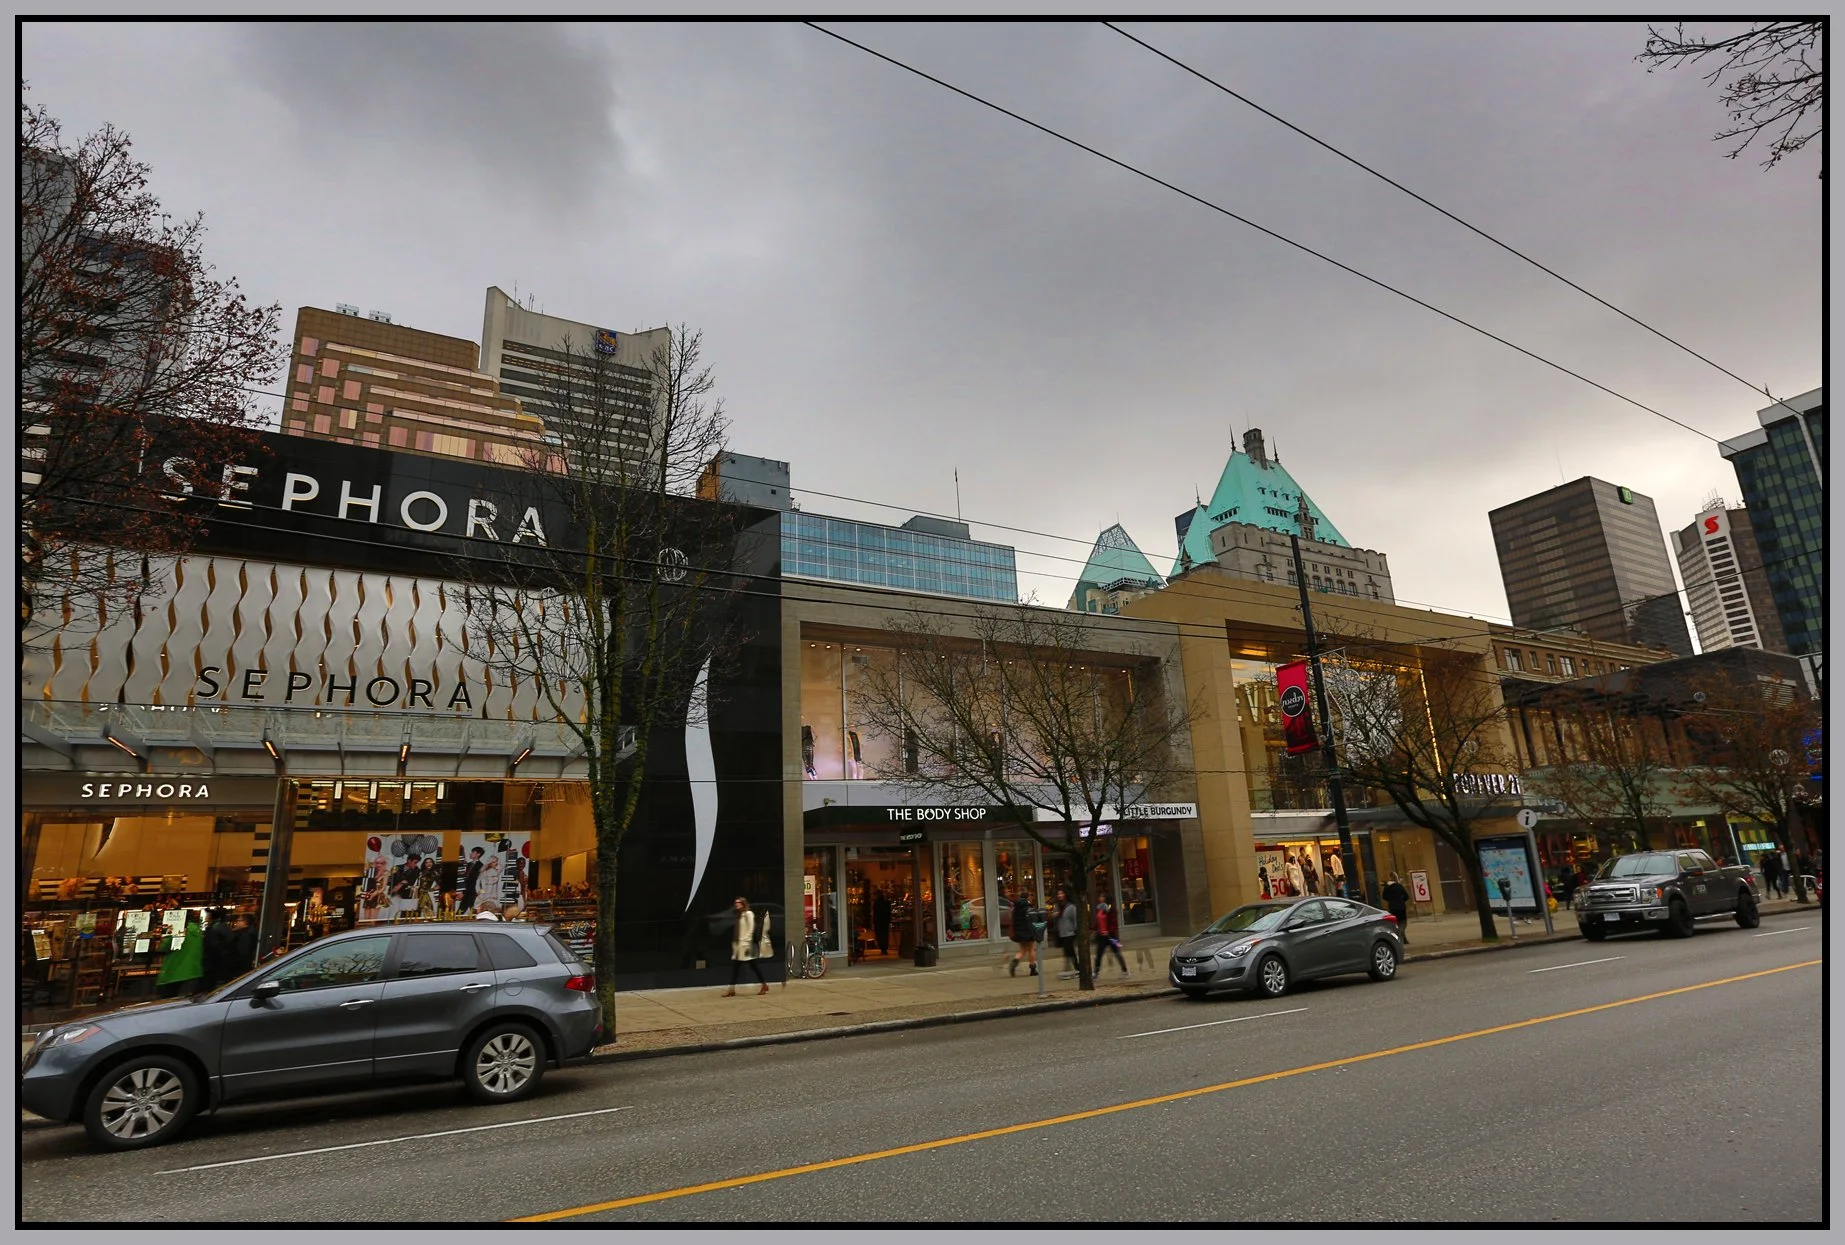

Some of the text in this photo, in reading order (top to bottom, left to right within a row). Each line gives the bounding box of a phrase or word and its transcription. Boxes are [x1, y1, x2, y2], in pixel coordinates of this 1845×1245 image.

[160, 455, 548, 546] SEPHORA
[196, 666, 472, 710] SEPHORA
[81, 783, 209, 798] SEPHORA
[1453, 773, 1521, 795] FOREVER 21
[887, 807, 987, 821] THE BODY SHOP
[1123, 806, 1192, 816] LITTLE BURGUNDY
